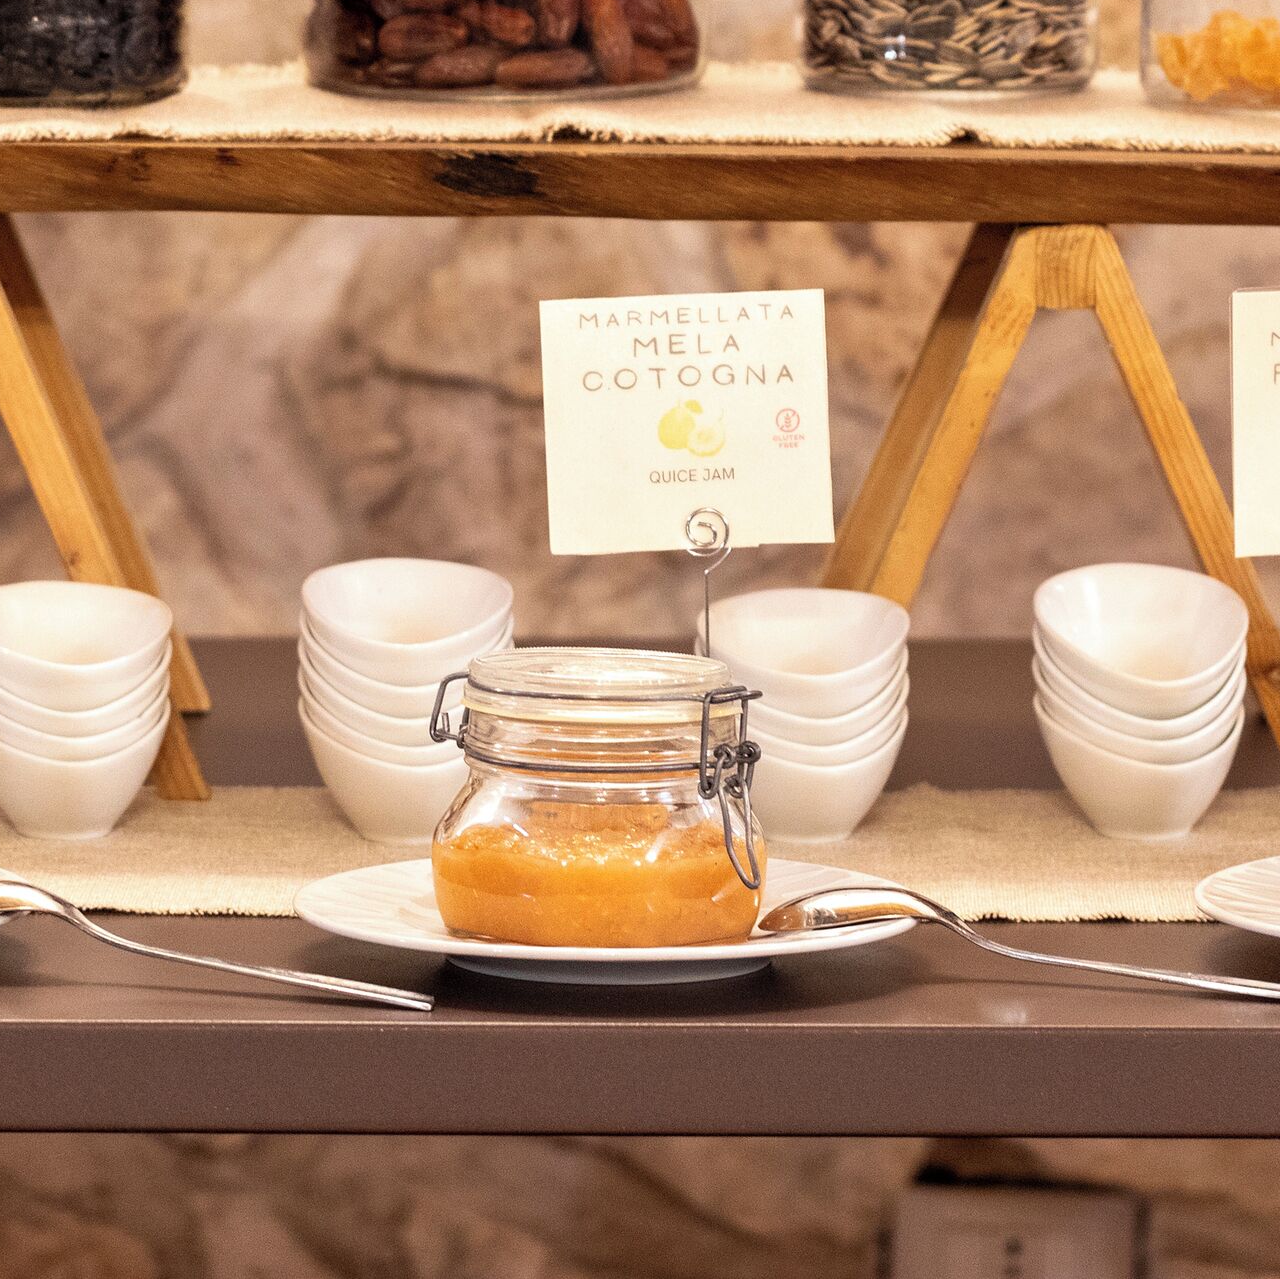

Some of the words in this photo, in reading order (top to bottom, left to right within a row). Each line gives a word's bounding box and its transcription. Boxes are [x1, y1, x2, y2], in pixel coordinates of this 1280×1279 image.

[579, 303, 794, 329] MARMELLATA
[633, 333, 740, 358] MELA
[582, 363, 794, 392] COTOGNA
[772, 433, 805, 442] GLUTEN
[649, 468, 697, 484] QUICE
[703, 467, 735, 481] JAM
